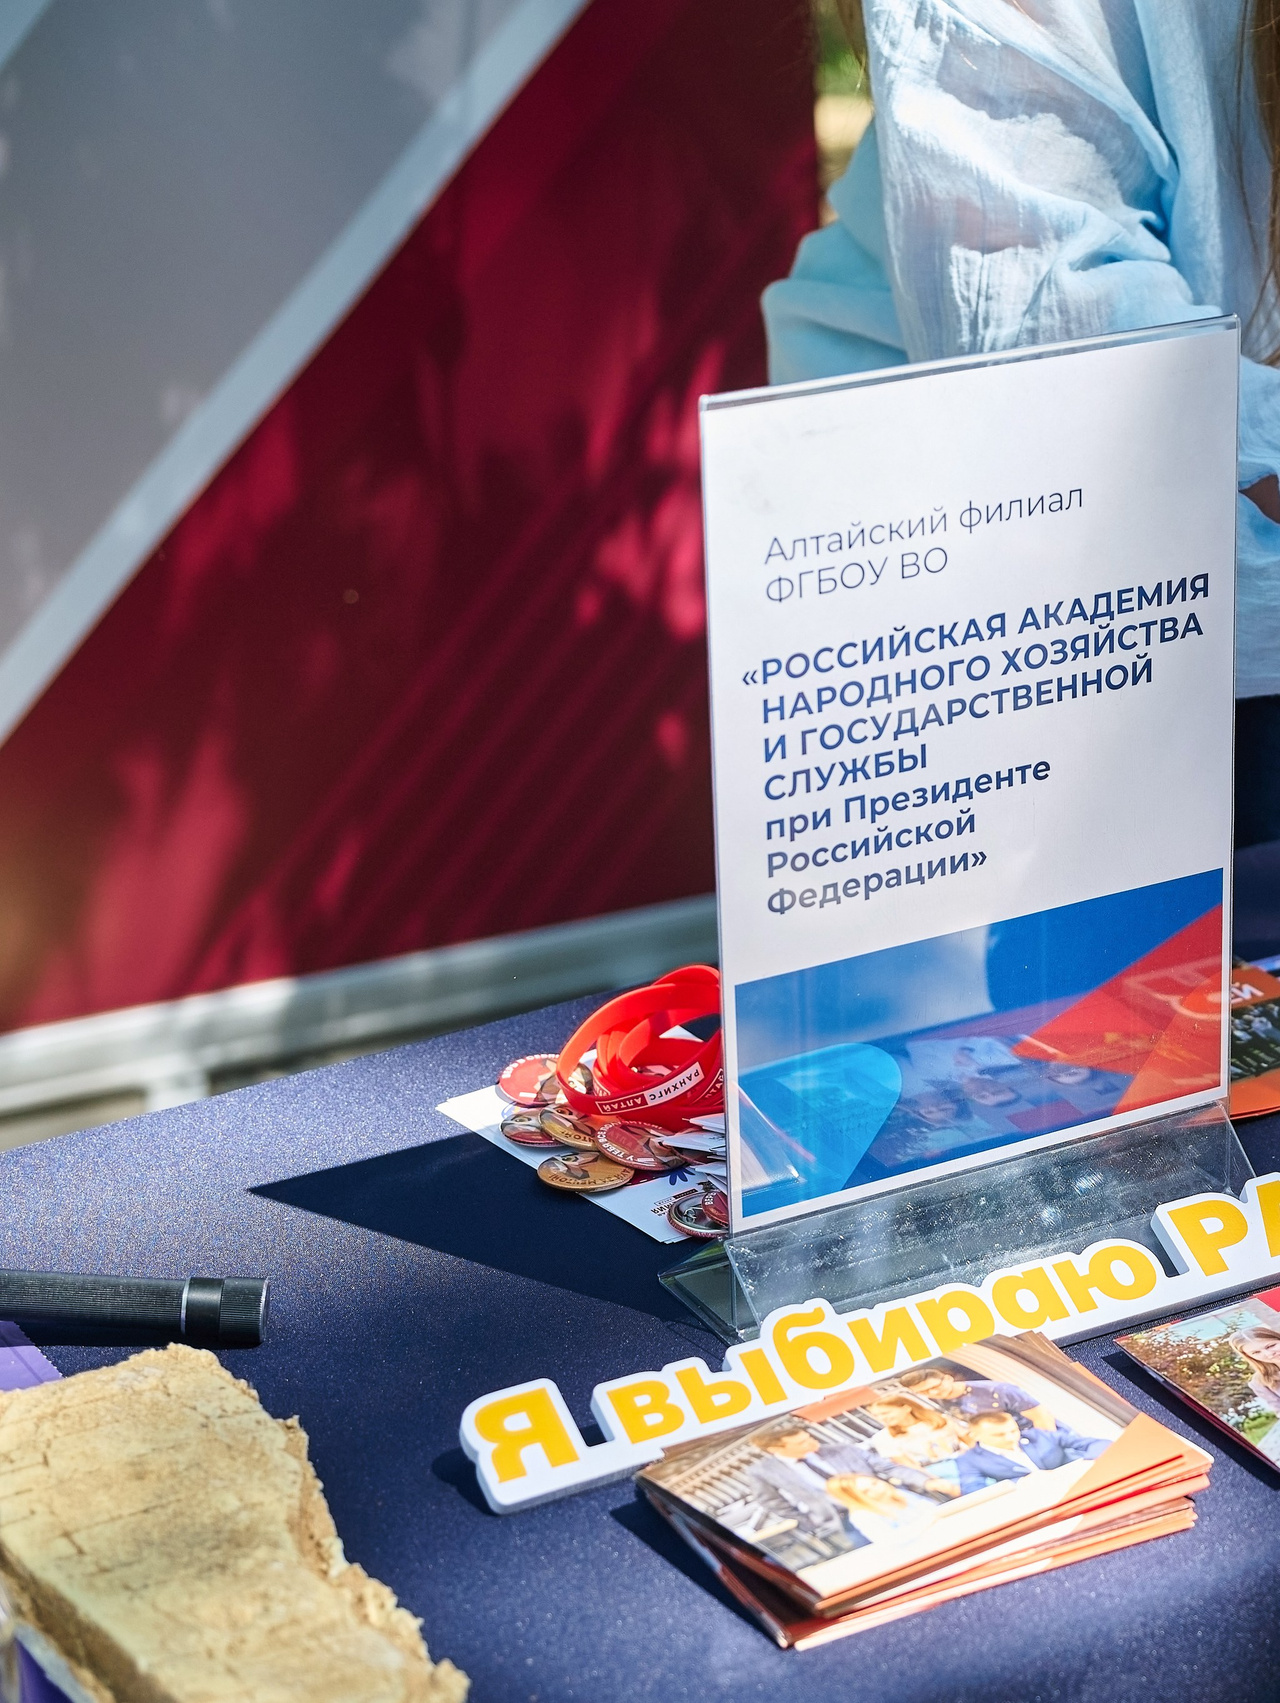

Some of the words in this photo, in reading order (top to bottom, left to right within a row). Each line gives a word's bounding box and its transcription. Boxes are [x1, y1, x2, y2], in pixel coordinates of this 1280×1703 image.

[764, 507, 948, 565] Алтайский
[960, 488, 1083, 535] филиал
[766, 557, 888, 603] ФГБОУ
[900, 547, 948, 580] ВО
[742, 612, 1006, 686] «РОССИЙСКАЯ
[1018, 573, 1210, 634] АКАДЕМИЯ
[762, 656, 990, 723] НАРОДНОГО
[1002, 612, 1203, 675] ХОЗЯЙСТВА
[763, 735, 787, 763] И
[801, 652, 1153, 755] ГОСУДАРСТВЕННОЙ
[764, 744, 927, 801] СЛУЖБЫ
[766, 813, 832, 841] при
[844, 758, 1051, 825] Президенте
[767, 809, 976, 877] Российской
[767, 850, 987, 916] Федерации»
[603, 1097, 642, 1112] АЛТАЙ
[648, 1068, 700, 1101] РАНХИГС
[475, 1388, 579, 1483] Я
[606, 1245, 1158, 1445] выбираю
